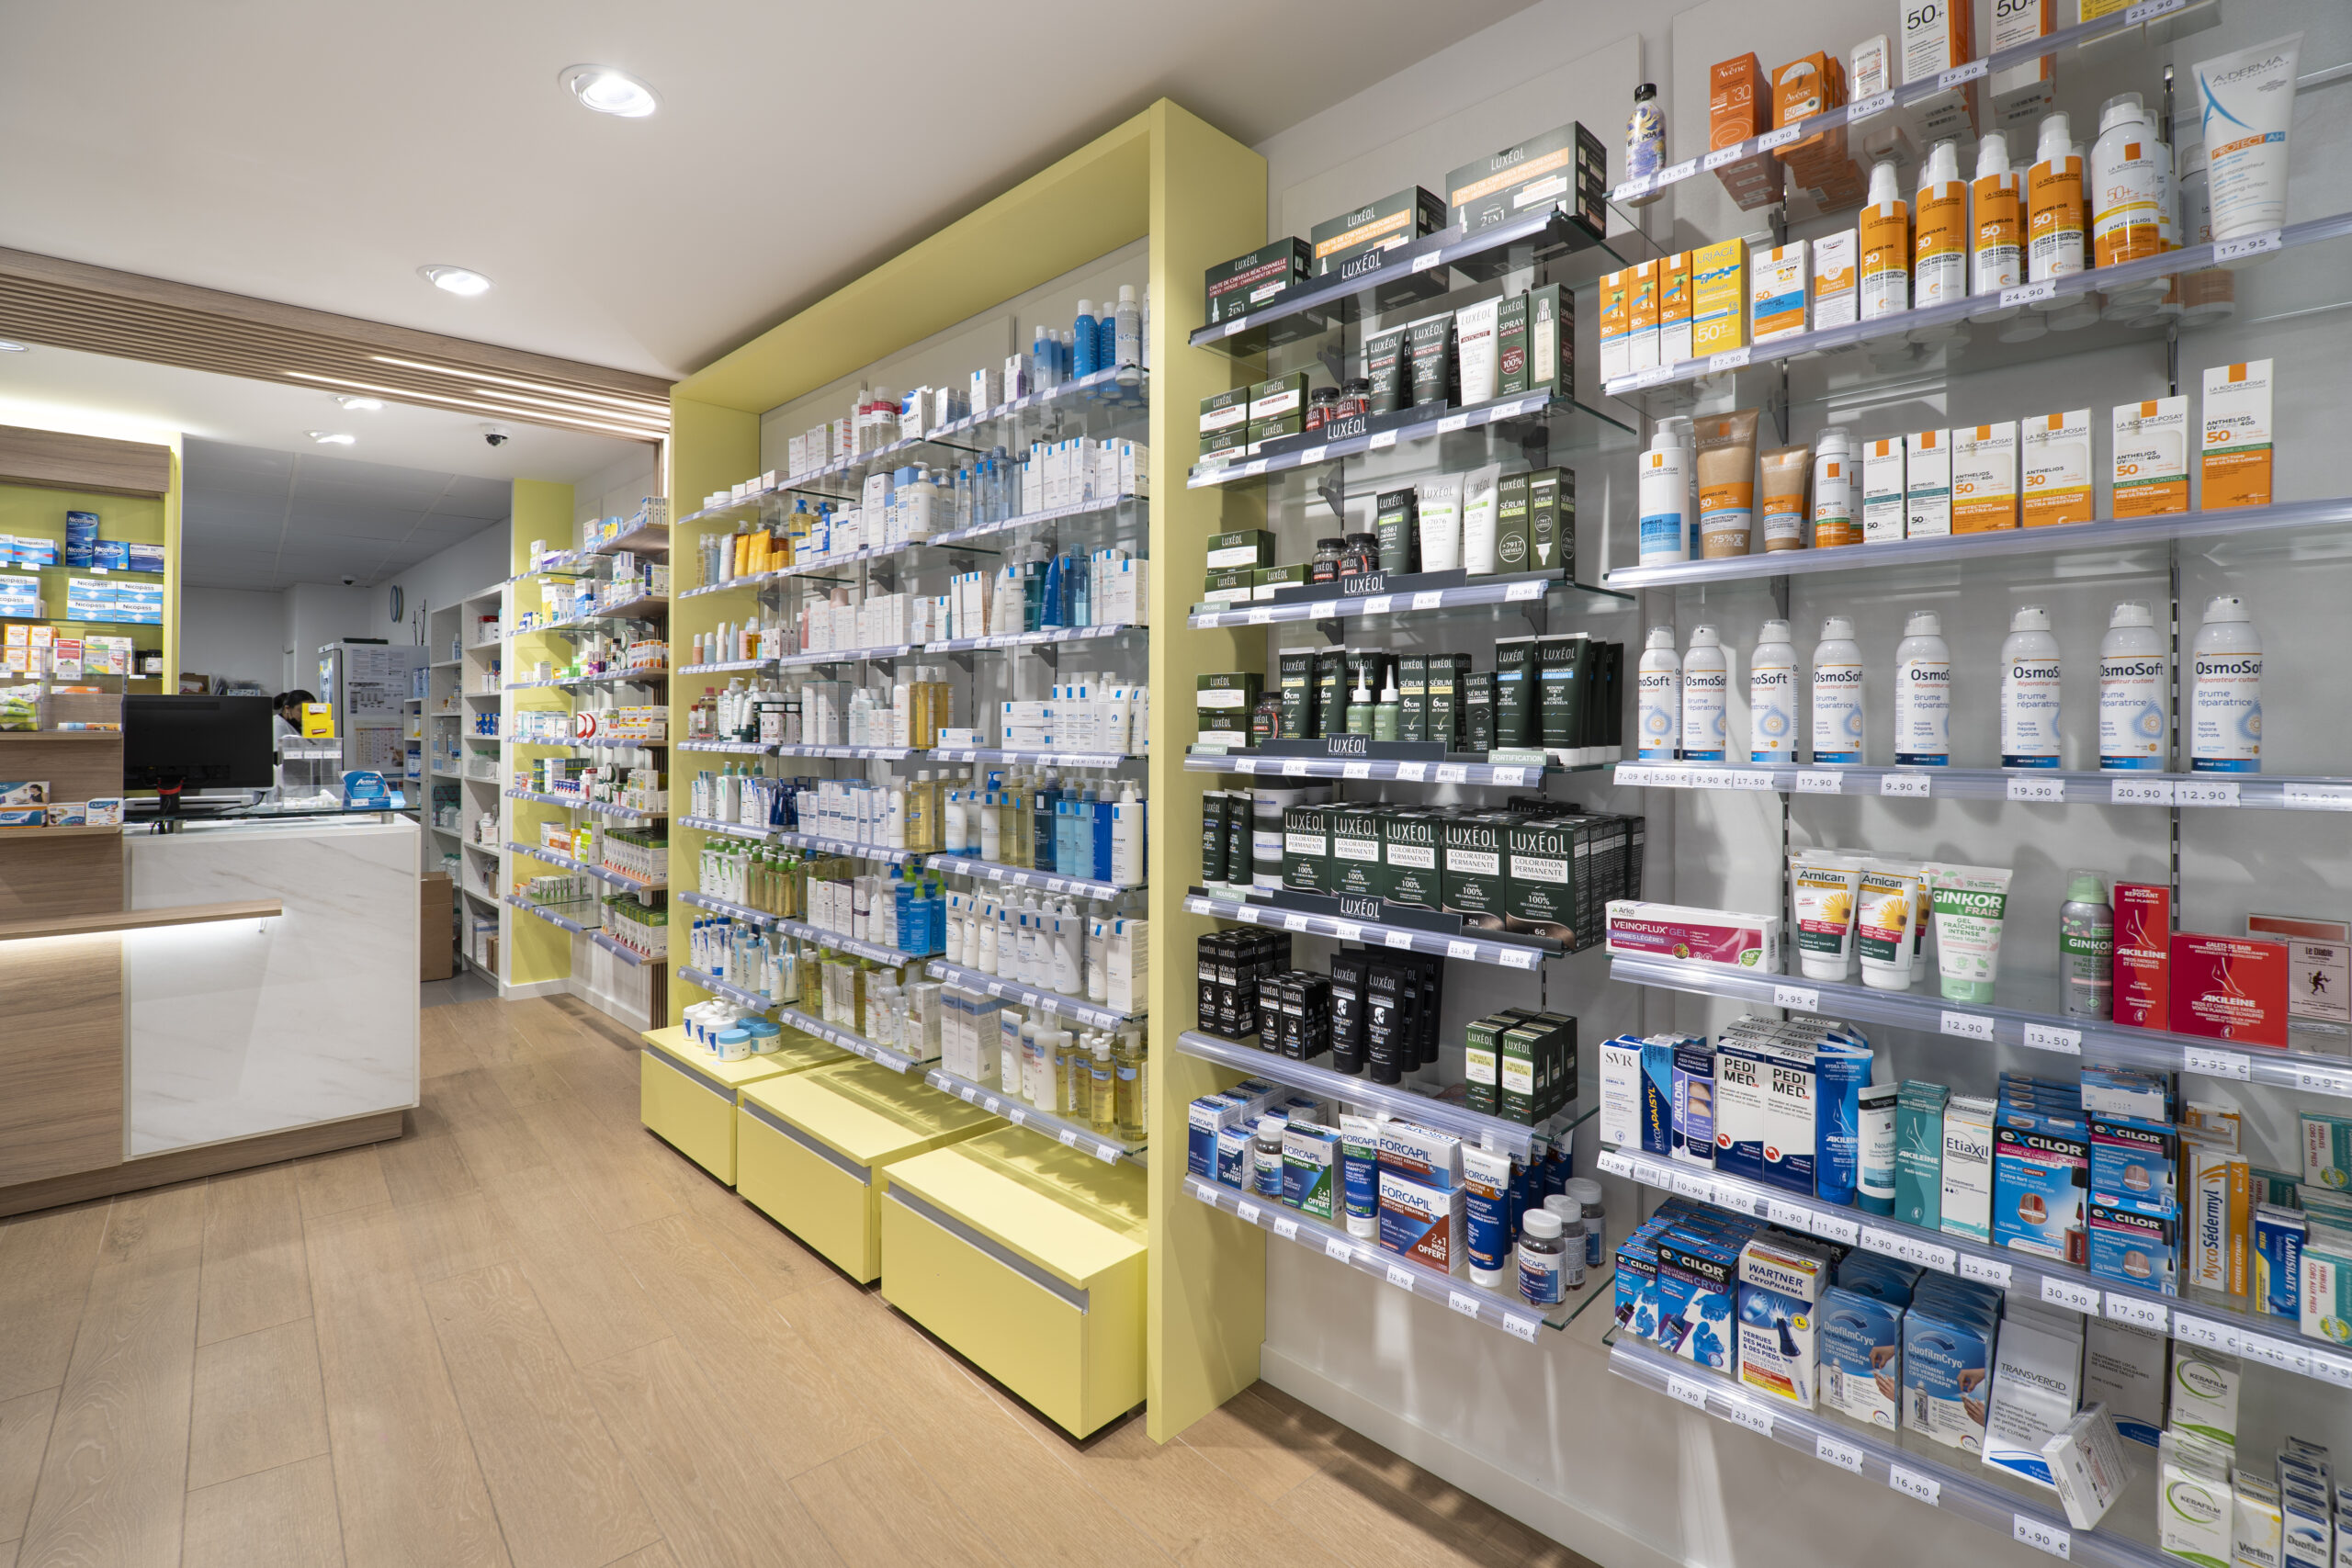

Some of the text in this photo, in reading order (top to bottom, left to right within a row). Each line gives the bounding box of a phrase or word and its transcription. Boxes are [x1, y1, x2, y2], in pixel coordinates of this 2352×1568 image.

[1719, 64, 1747, 78] Avène
[1944, 66, 1977, 83] 19.90
[2212, 55, 2283, 84] A-DERMA
[1785, 89, 1811, 104] Avène
[1853, 99, 1884, 114] 16.90
[2212, 135, 2264, 158] PROTECT
[1491, 147, 1524, 171] LUXÉOL
[1823, 239, 1844, 249] Eucerin
[1917, 236, 1930, 250] 30
[2221, 239, 2267, 255] 17.95
[1697, 245, 1735, 264] URIAGE
[1865, 253, 1879, 265] 30
[1342, 251, 1381, 279] LUXÉOL
[2006, 288, 2044, 301] 24.90
[1499, 299, 1524, 316] LUXÉOL
[1414, 322, 1443, 340] LUXÉOL
[1499, 318, 1524, 332] SPRAY
[1371, 335, 1397, 354] LUXÉOL
[1328, 417, 1366, 439] LUXÉOL
[2207, 416, 2250, 426] ANTHELIOS
[2117, 450, 2156, 460] ANTHELIOS
[2026, 466, 2064, 475] ANTHELIOS
[1499, 478, 1525, 491] LUXÉOL
[2026, 475, 2045, 487] 30
[1422, 486, 1453, 500] LUXÉOL
[1379, 494, 1404, 509] LUXÉOL
[1500, 499, 1525, 510] SÉRUM
[1344, 575, 1385, 594] LUXÉOL
[1498, 649, 1524, 661] LUXÉOL
[1544, 647, 1575, 660] LUXÉOL
[1329, 739, 1366, 754] LUXÉOL
[1492, 754, 1543, 762] FORTIFICATION
[2014, 787, 2051, 795] 19.90
[2119, 789, 2160, 797] 20.90
[2182, 791, 2225, 799] 12.90
[1286, 812, 1327, 831] LUXÉOL
[1334, 816, 1379, 836] LUXÉOL
[1386, 821, 1434, 842] LUXÉOL
[1446, 827, 1498, 848] LUXÉOL
[1510, 831, 1567, 853] LUXÉOL
[1338, 847, 1374, 855] PERMANENTE
[1390, 846, 1430, 856] COLORATION
[1390, 853, 1431, 864] PERMANENTE
[1451, 852, 1494, 861] COLORATION
[1451, 860, 1494, 868] PERMANENTE
[1515, 858, 1563, 868] COLORATION
[1515, 866, 1563, 876] PERMANENTE
[1800, 870, 1845, 882] Arnican
[1862, 874, 1902, 887] Arnican
[1216, 891, 1238, 899] NOUVEAU
[1463, 887, 1482, 896] 100%
[1528, 896, 1550, 905] 100%
[1933, 891, 2002, 908] GINKOR
[1340, 898, 1379, 917] LUXÉOL
[1965, 907, 1999, 917] FRAIS
[1614, 921, 1687, 937] VEINOFLUX GEL
[1943, 921, 1985, 931] FRAÎCHEUR
[1948, 929, 1980, 937] INTENSE
[1964, 936, 1987, 944] légères
[2117, 947, 2166, 959] AKILEÏNE
[2313, 948, 2333, 956] Diable
[1369, 974, 1396, 989] LUXÉOL
[1778, 993, 1803, 1003] 9.95
[2201, 994, 2256, 1007] AKILEÏNE
[1947, 1021, 1983, 1033] 12.90
[1468, 1032, 1493, 1046] LUXÉOL
[2030, 1033, 2069, 1045] 13.50
[1505, 1039, 1530, 1055] LUXÉOL
[1606, 1053, 1633, 1067] SVR
[1724, 1058, 1756, 1073] PEDI
[2191, 1058, 2246, 1073] 9.95 €
[1773, 1068, 1806, 1085] PEDI
[1675, 1079, 1683, 1123] AKILDIA
[1342, 1134, 1377, 1146] FORCAPIL
[1380, 1138, 1431, 1162] FORCAPIL
[1601, 1158, 1624, 1171] 13.90
[1898, 1151, 1939, 1165] AKILEÏNE
[2057, 1156, 2082, 1165] FORTE
[1464, 1168, 1501, 1186] FORCAPIL
[1382, 1185, 1432, 1211] FORCAPIL
[1772, 1208, 1802, 1223] 11.90
[1817, 1222, 1848, 1236] 11.90
[2202, 1189, 2223, 1281] MycoSédermyl
[1865, 1236, 1905, 1254] 9.90 €
[1419, 1245, 1446, 1261] OFFERT
[1910, 1247, 1944, 1264] 12.00
[2285, 1234, 2298, 1293] LAMISILATE
[1748, 1264, 1804, 1287] WARTNER
[1965, 1264, 1999, 1279] 12.90
[1694, 1277, 1724, 1292] CRYO
[2047, 1287, 2086, 1305] 30.90
[2112, 1303, 2154, 1321] 17.90
[1744, 1330, 1772, 1344] VERRUES
[1825, 1321, 1874, 1345] DuofilmCryo
[2180, 1325, 2235, 1347] 8.75 €
[1744, 1337, 1776, 1353] DES MAINS
[1908, 1342, 1962, 1368] DuofilmCryo
[2245, 1343, 2305, 1367] 8.40 €
[2001, 1362, 2066, 1391] TRANSVERCID
[2189, 1371, 2227, 1390] KERAFILM
[1672, 1384, 1698, 1401] 17.90
[1736, 1411, 1763, 1427] 23.90
[1821, 1446, 1852, 1464] 20.90
[1895, 1475, 1928, 1495] 16.90
[2180, 1495, 2221, 1515] KERAFILM
[2019, 1527, 2066, 1552] 9.90 €
[2288, 1535, 2326, 1556] Duofilm
[2239, 1541, 2274, 1562] Verlim
